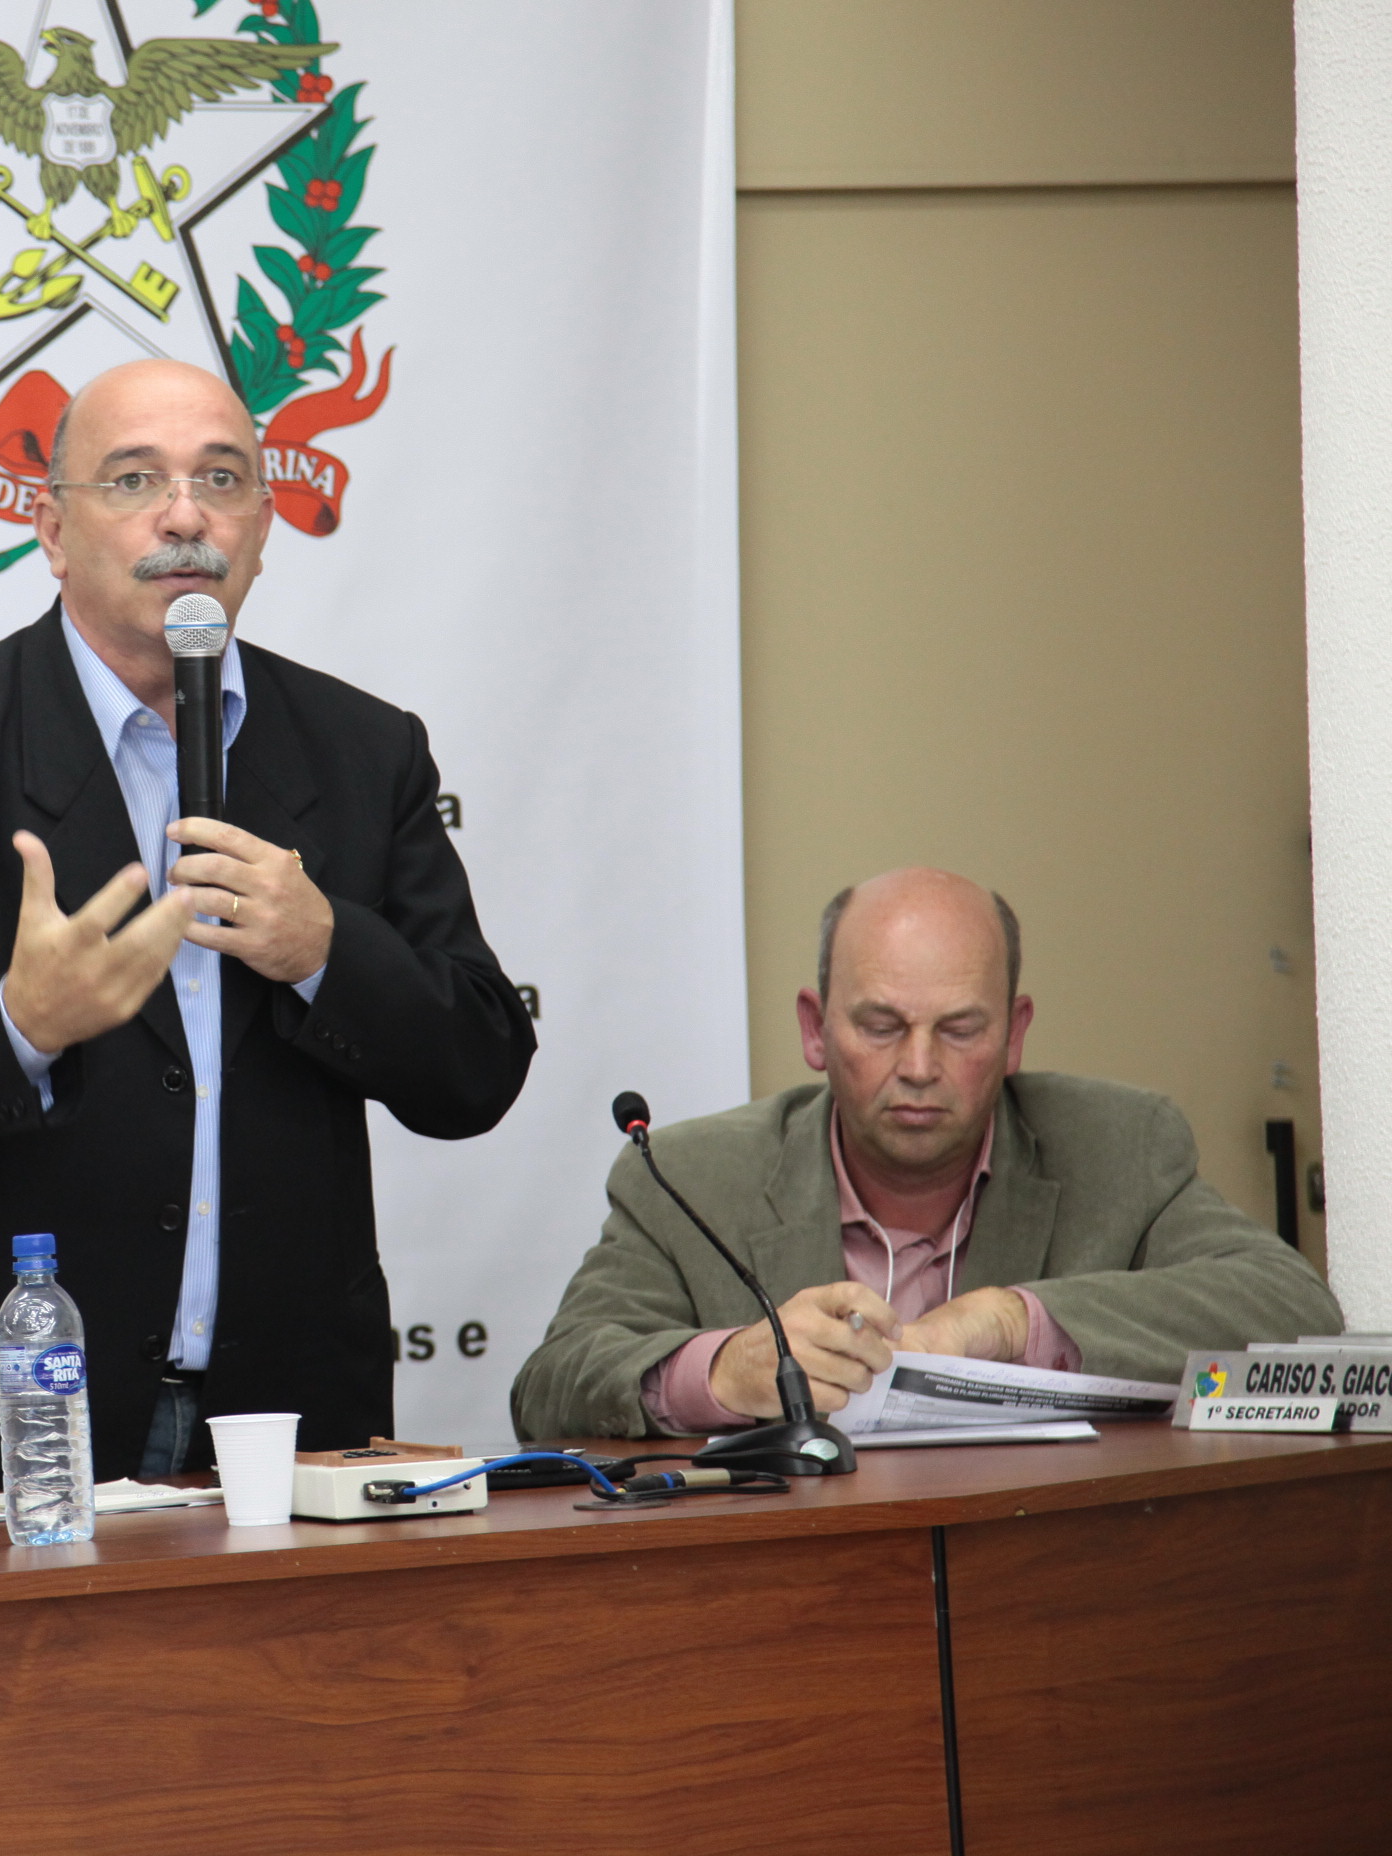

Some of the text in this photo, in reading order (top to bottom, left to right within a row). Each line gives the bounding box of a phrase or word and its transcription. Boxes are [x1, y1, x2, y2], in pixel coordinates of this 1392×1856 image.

[261, 447, 335, 499] RINA
[457, 1320, 488, 1359] e
[43, 1354, 82, 1371] SANTA
[53, 1367, 80, 1383] RITA
[1246, 1361, 1316, 1395] CARISO
[1319, 1363, 1336, 1395] S.
[1225, 1402, 1321, 1420] SECRETÁRIO
[1336, 1402, 1381, 1418] ADOR
